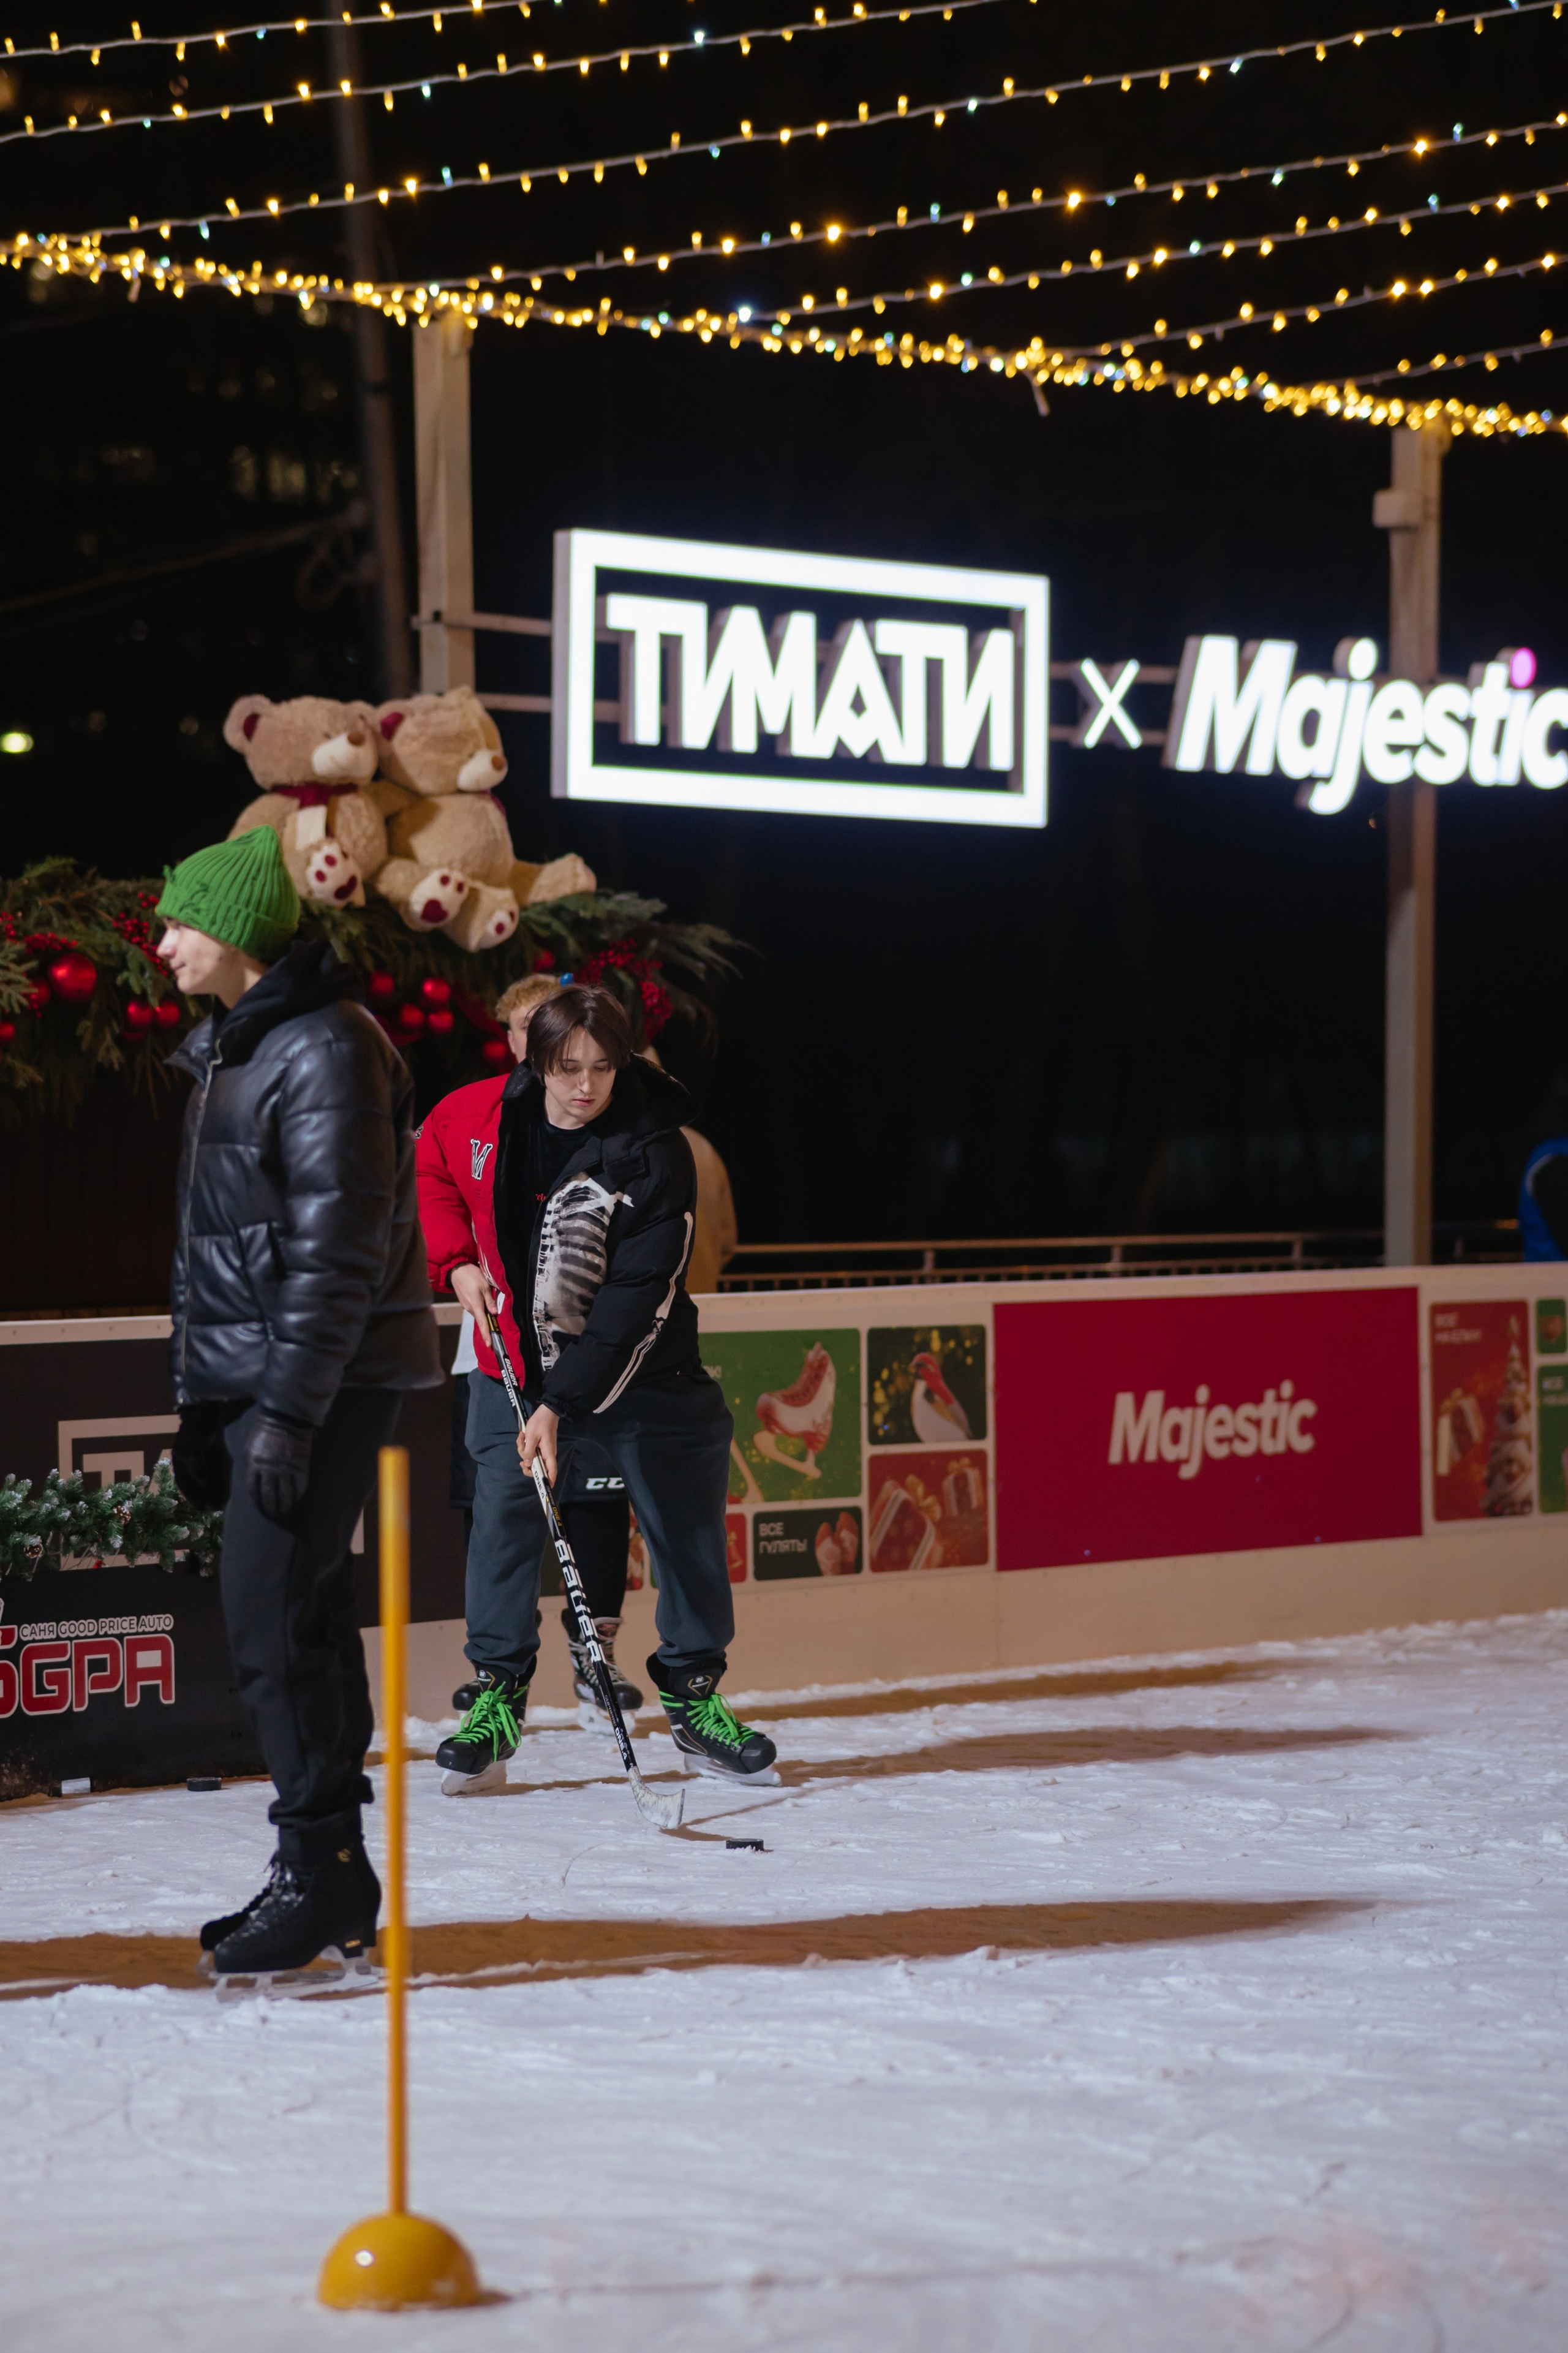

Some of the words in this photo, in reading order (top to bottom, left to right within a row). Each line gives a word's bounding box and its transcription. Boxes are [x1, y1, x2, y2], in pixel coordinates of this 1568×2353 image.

[608, 593, 1014, 771] ТИМАТИ
[1175, 634, 1568, 815] Majestic
[500, 1369, 516, 1408] BAUER
[504, 1357, 518, 1387] BAUER
[1107, 1379, 1317, 1480] Majestic
[759, 1522, 783, 1536] ВСЕ
[20, 1624, 56, 1639] САНЯ
[59, 1620, 97, 1636] GOOD
[100, 1617, 136, 1633] PRICE
[138, 1615, 173, 1631] AUTO
[554, 1539, 606, 1664] BAUER
